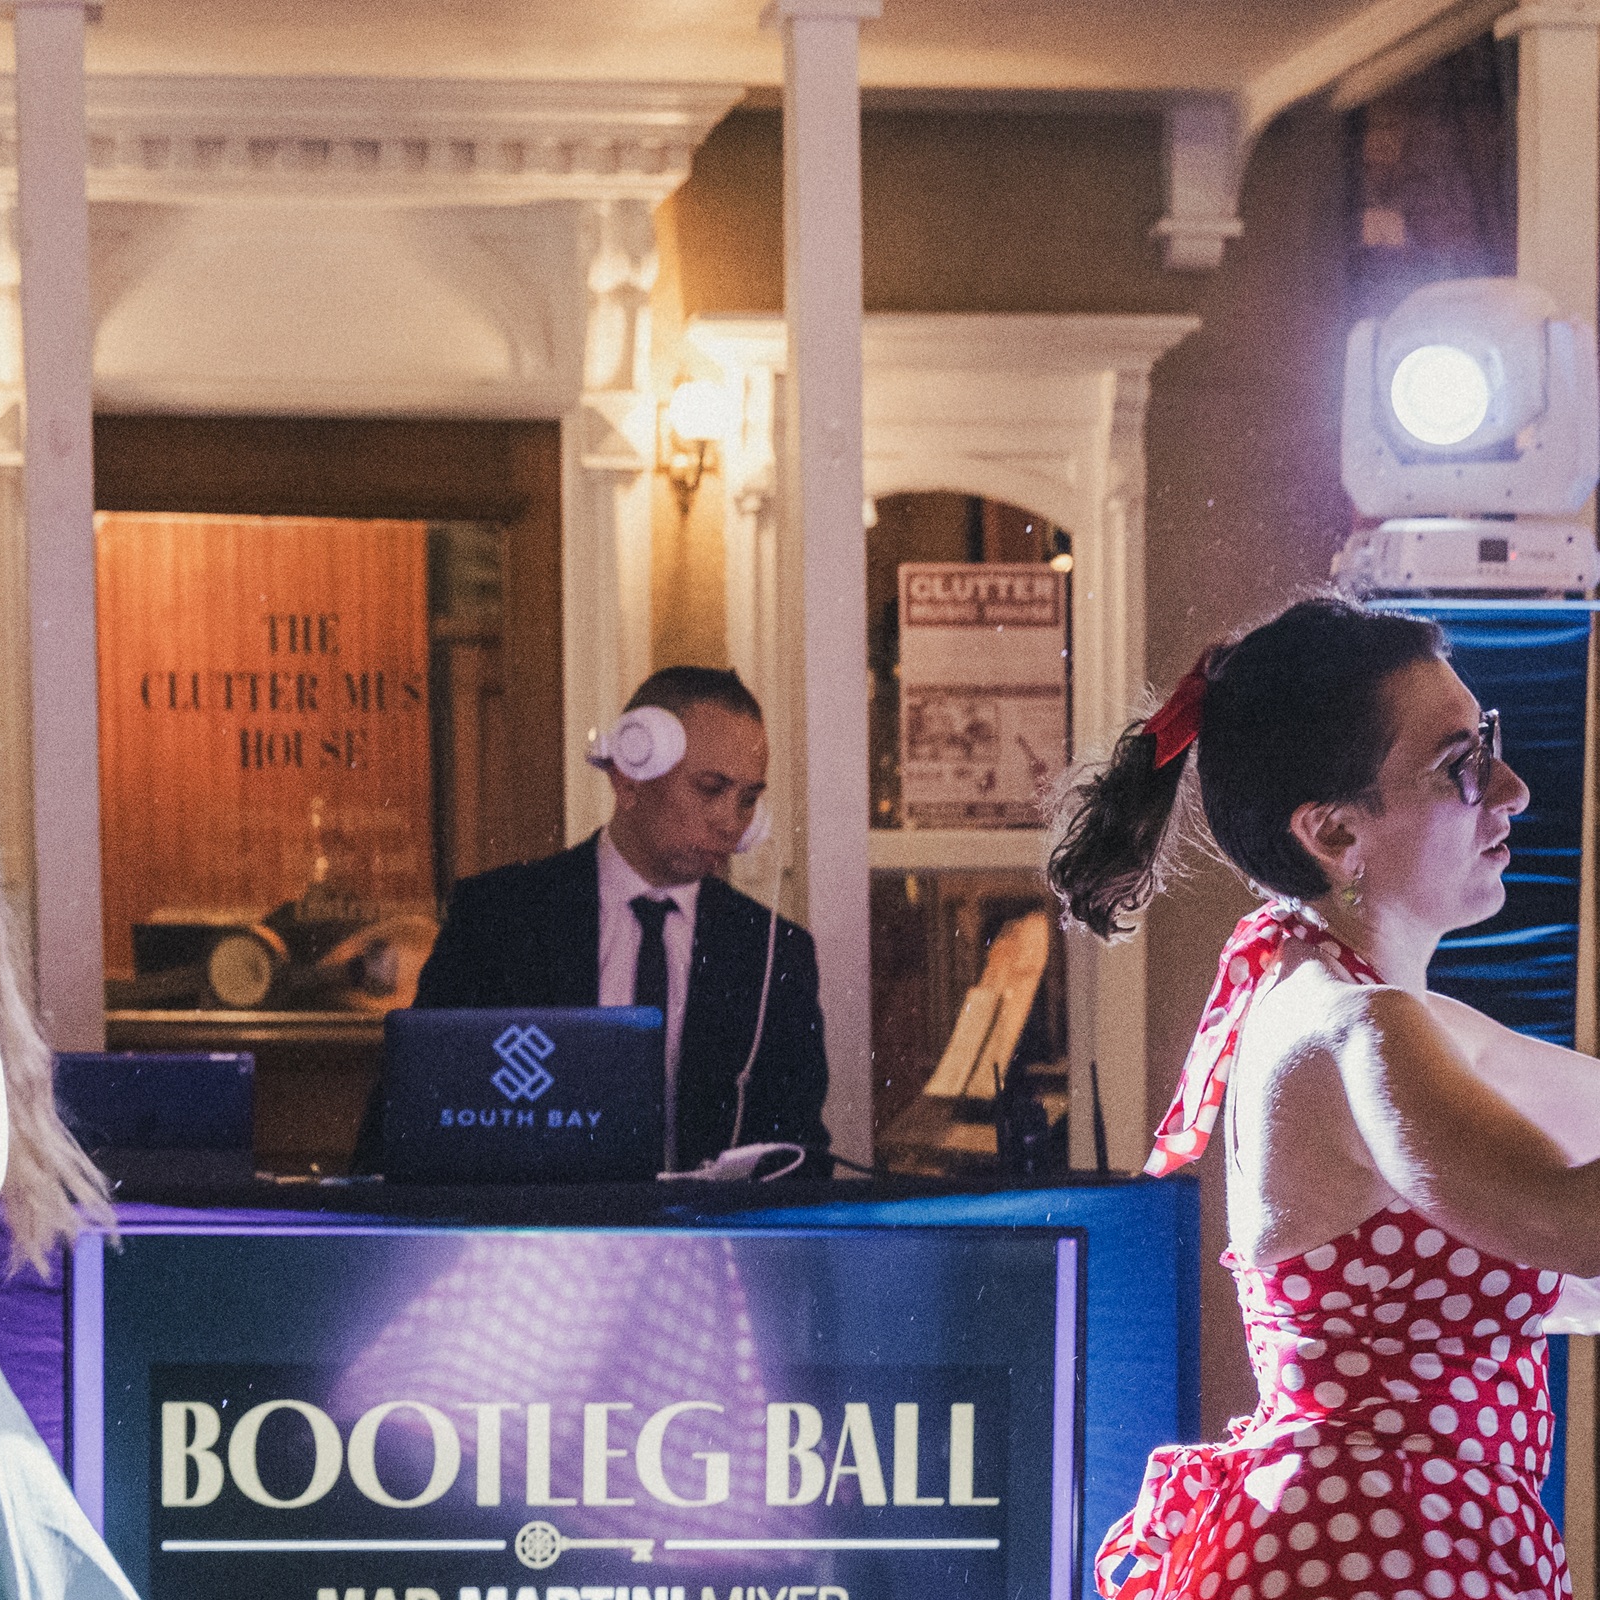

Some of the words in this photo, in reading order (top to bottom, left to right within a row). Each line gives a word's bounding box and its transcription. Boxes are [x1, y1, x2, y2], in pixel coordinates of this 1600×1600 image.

[262, 612, 340, 655] THE
[140, 671, 318, 713] CLUTTER
[239, 727, 369, 770] HOUSE
[439, 1108, 535, 1128] SOUTH
[547, 1108, 601, 1128] BAY
[161, 1399, 731, 1509] BOOTLEG
[765, 1402, 1000, 1507] BALL
